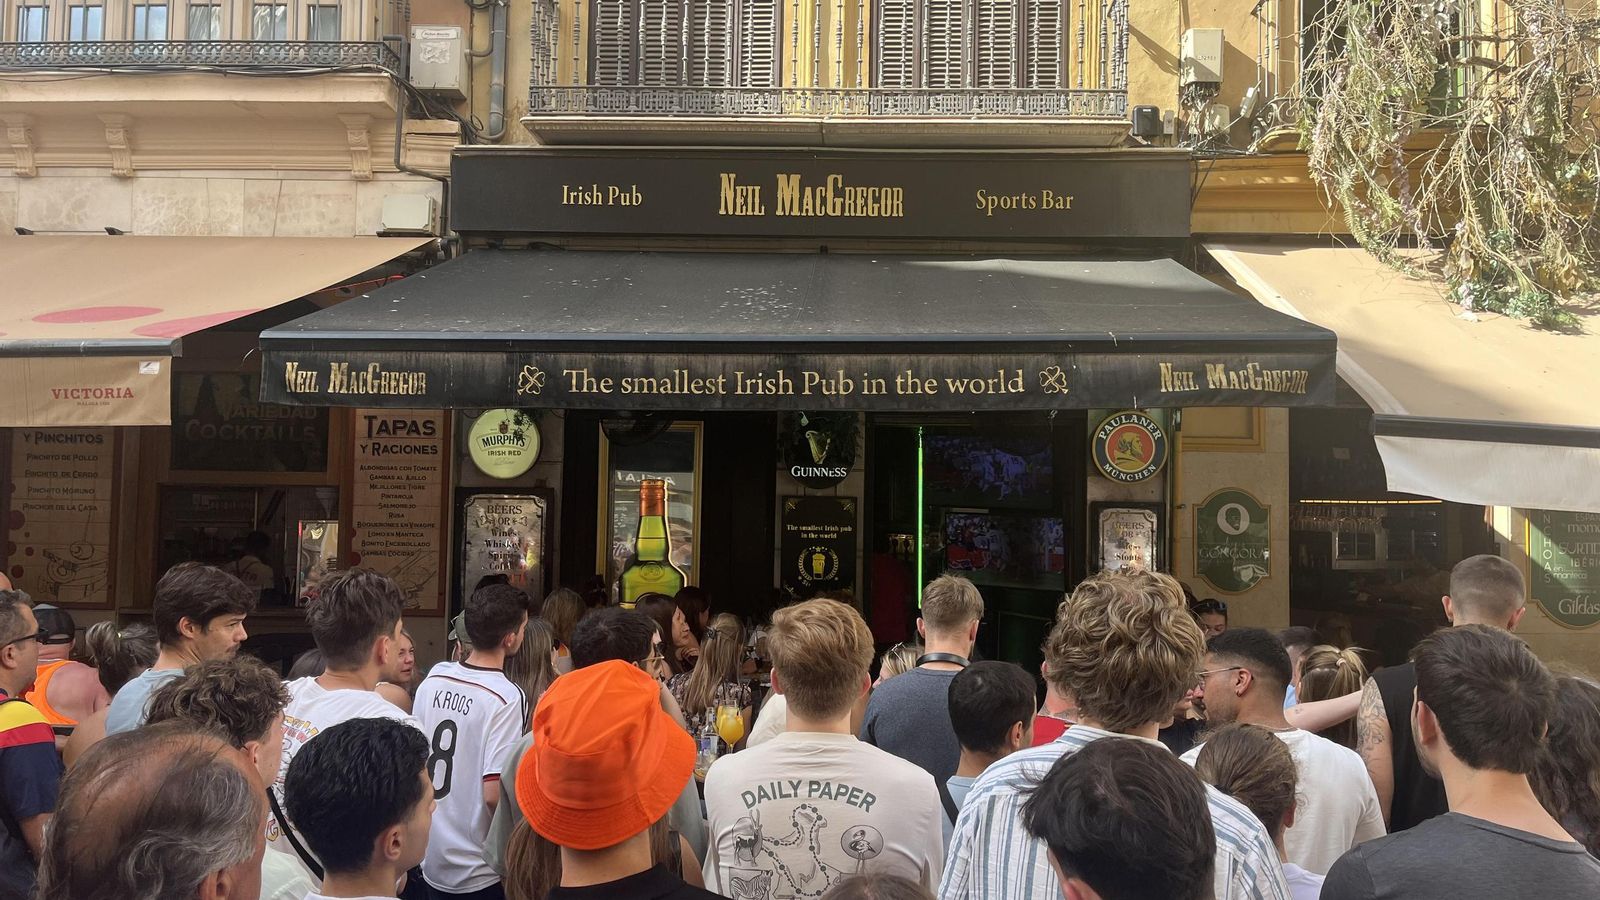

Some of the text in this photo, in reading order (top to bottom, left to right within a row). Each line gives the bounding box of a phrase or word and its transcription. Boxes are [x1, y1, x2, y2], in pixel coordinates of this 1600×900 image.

[562, 184, 643, 206] Irish Pub
[975, 189, 1074, 216] Sports Bar
[562, 368, 1025, 395] The smallest Irish Pub in the world
[51, 387, 134, 400] VICTORIA
[363, 415, 436, 438] TAPAS
[1099, 414, 1162, 440] PAULANER
[34, 431, 104, 445] PINCHITOS
[360, 442, 438, 456] Y RACIONES
[791, 465, 847, 477] GUINNESS
[487, 504, 523, 515] BEERS
[497, 517, 511, 526] OR
[484, 539, 521, 553] Whiskey
[1570, 557, 1600, 568] IBÉRI
[1552, 571, 1588, 579] manteca
[1558, 595, 1600, 615] Gildas
[432, 690, 474, 716] KROOS
[426, 718, 458, 801] 8
[741, 780, 877, 813] DAILY PAPER
